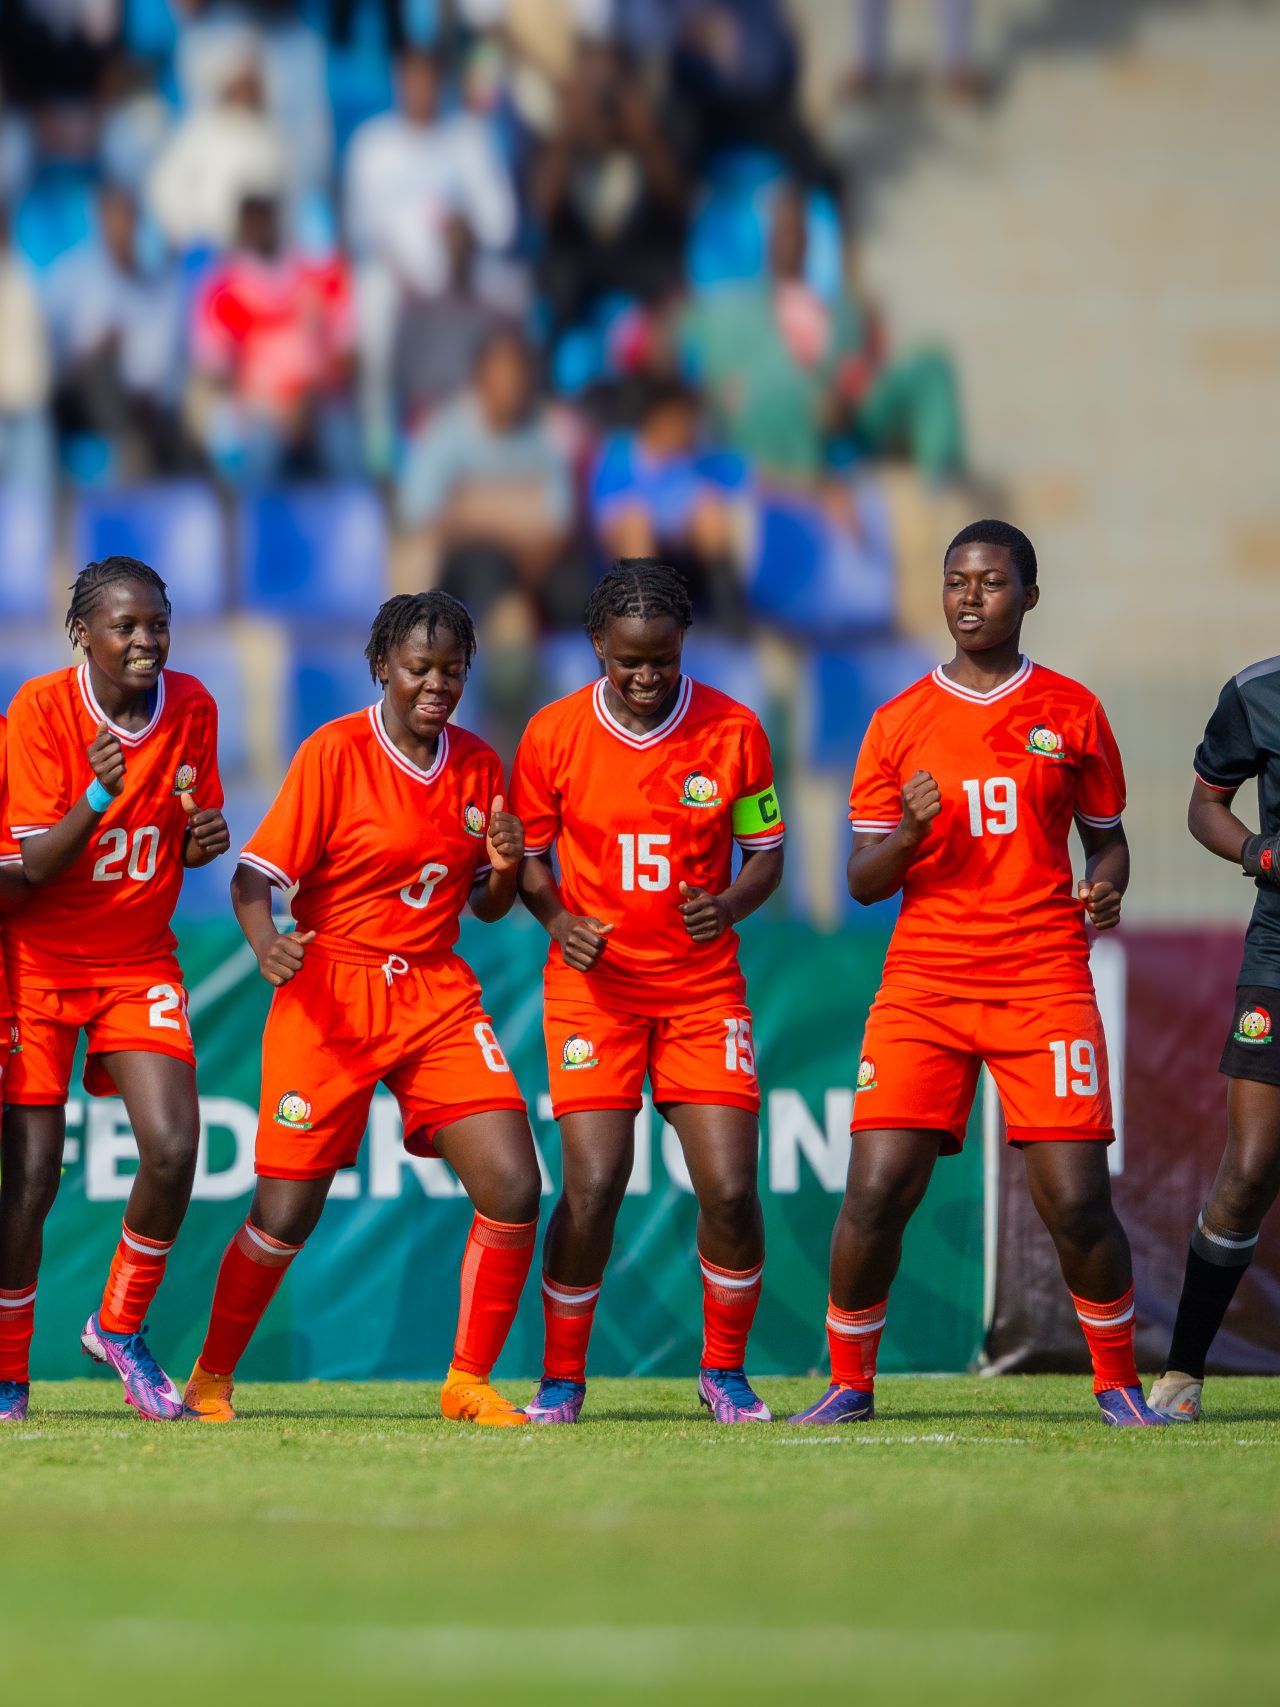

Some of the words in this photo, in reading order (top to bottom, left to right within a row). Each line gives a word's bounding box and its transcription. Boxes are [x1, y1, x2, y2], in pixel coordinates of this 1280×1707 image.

[758, 793, 777, 824] C
[963, 777, 1018, 837] 19
[93, 825, 160, 881] 20
[618, 834, 671, 892] 15
[474, 1022, 511, 1074] 8
[724, 1018, 755, 1076] 15
[1049, 1040, 1099, 1098] 19
